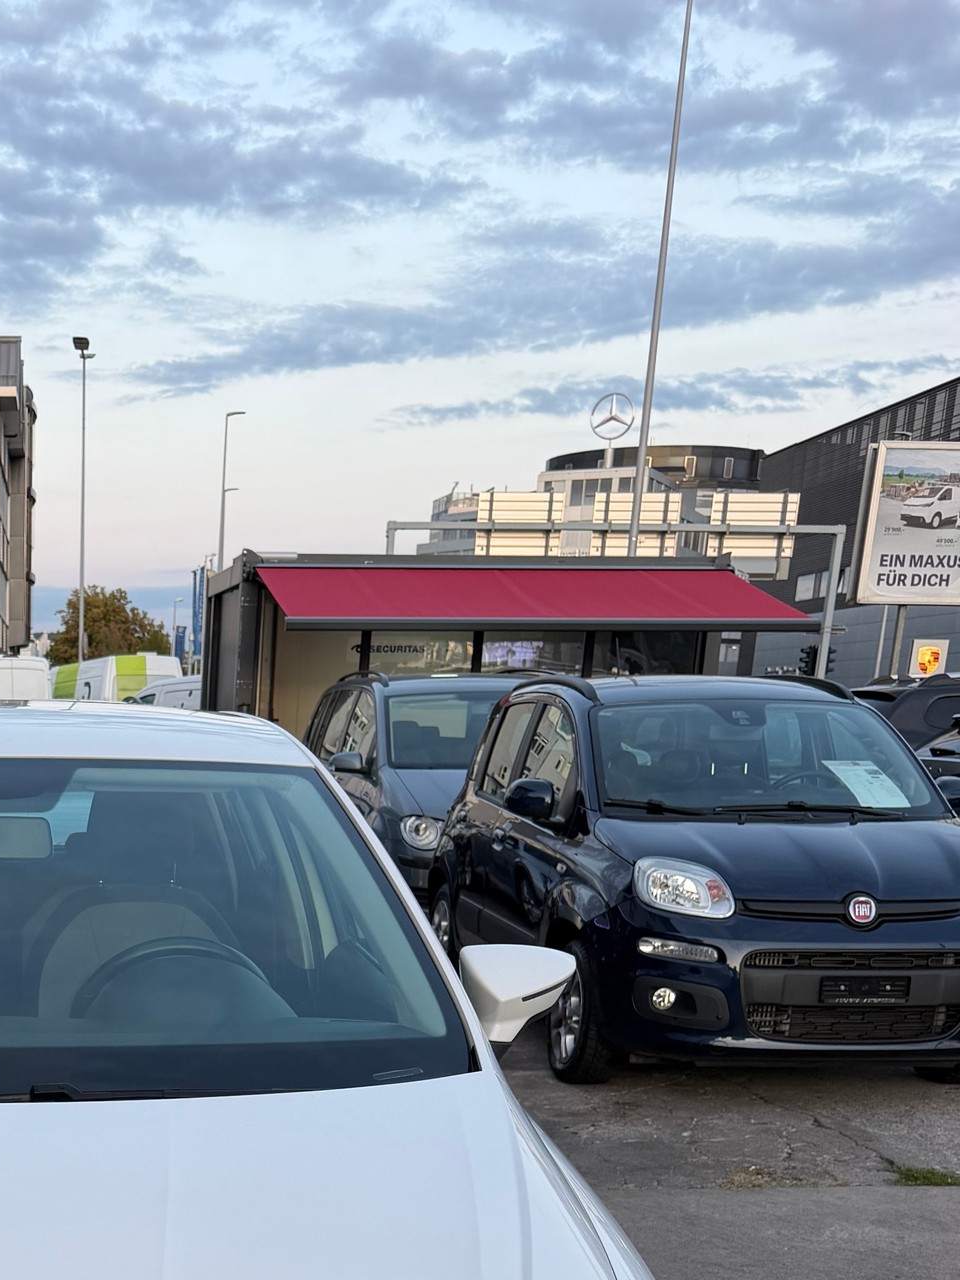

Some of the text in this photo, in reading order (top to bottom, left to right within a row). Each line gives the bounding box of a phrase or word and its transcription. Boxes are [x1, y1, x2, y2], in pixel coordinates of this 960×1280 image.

[879, 553, 906, 568] EIN
[876, 569, 951, 587] FÜR DICH
[369, 644, 425, 654] SECURITAS
[855, 904, 871, 917] FIAT
